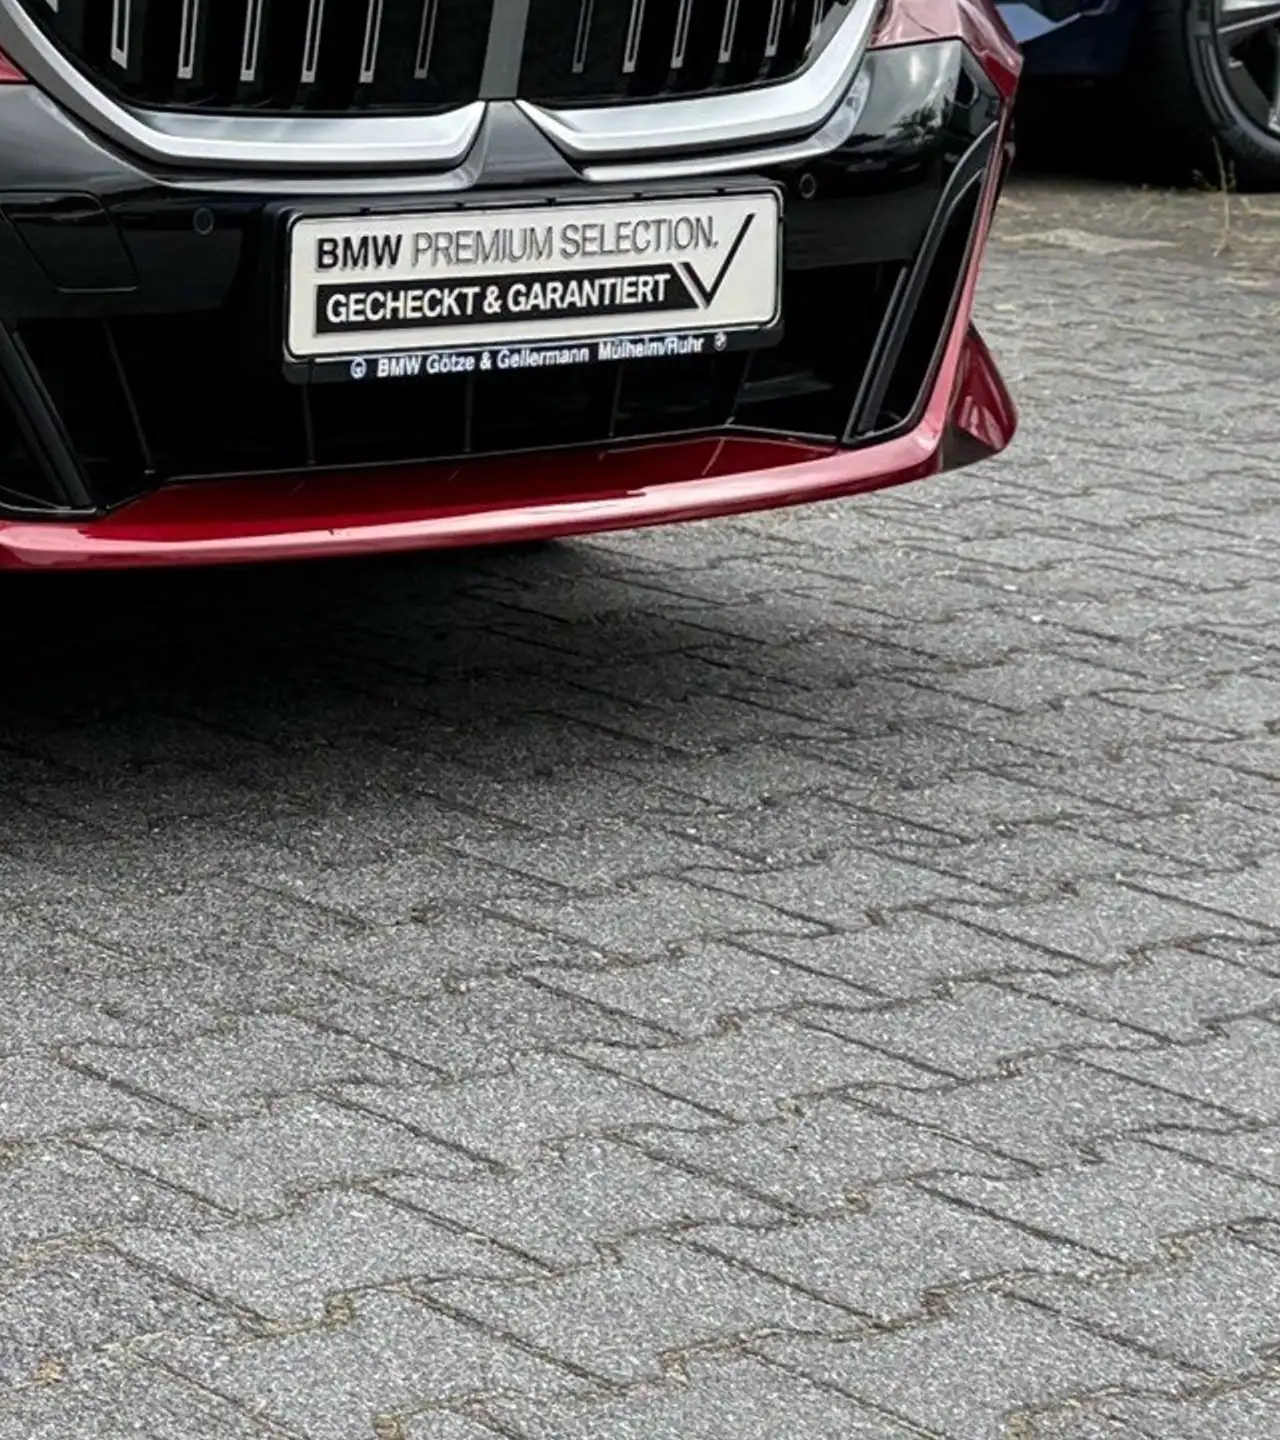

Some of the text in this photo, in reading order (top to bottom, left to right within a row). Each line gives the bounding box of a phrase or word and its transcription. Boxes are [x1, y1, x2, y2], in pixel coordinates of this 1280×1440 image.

[317, 234, 403, 270] BMW
[411, 226, 554, 268] PREMIUM
[326, 273, 672, 324] GECHECKT & GARANTIERT
[376, 335, 705, 378] BMW Götze & Gellermann Mülheim/Ruhr
